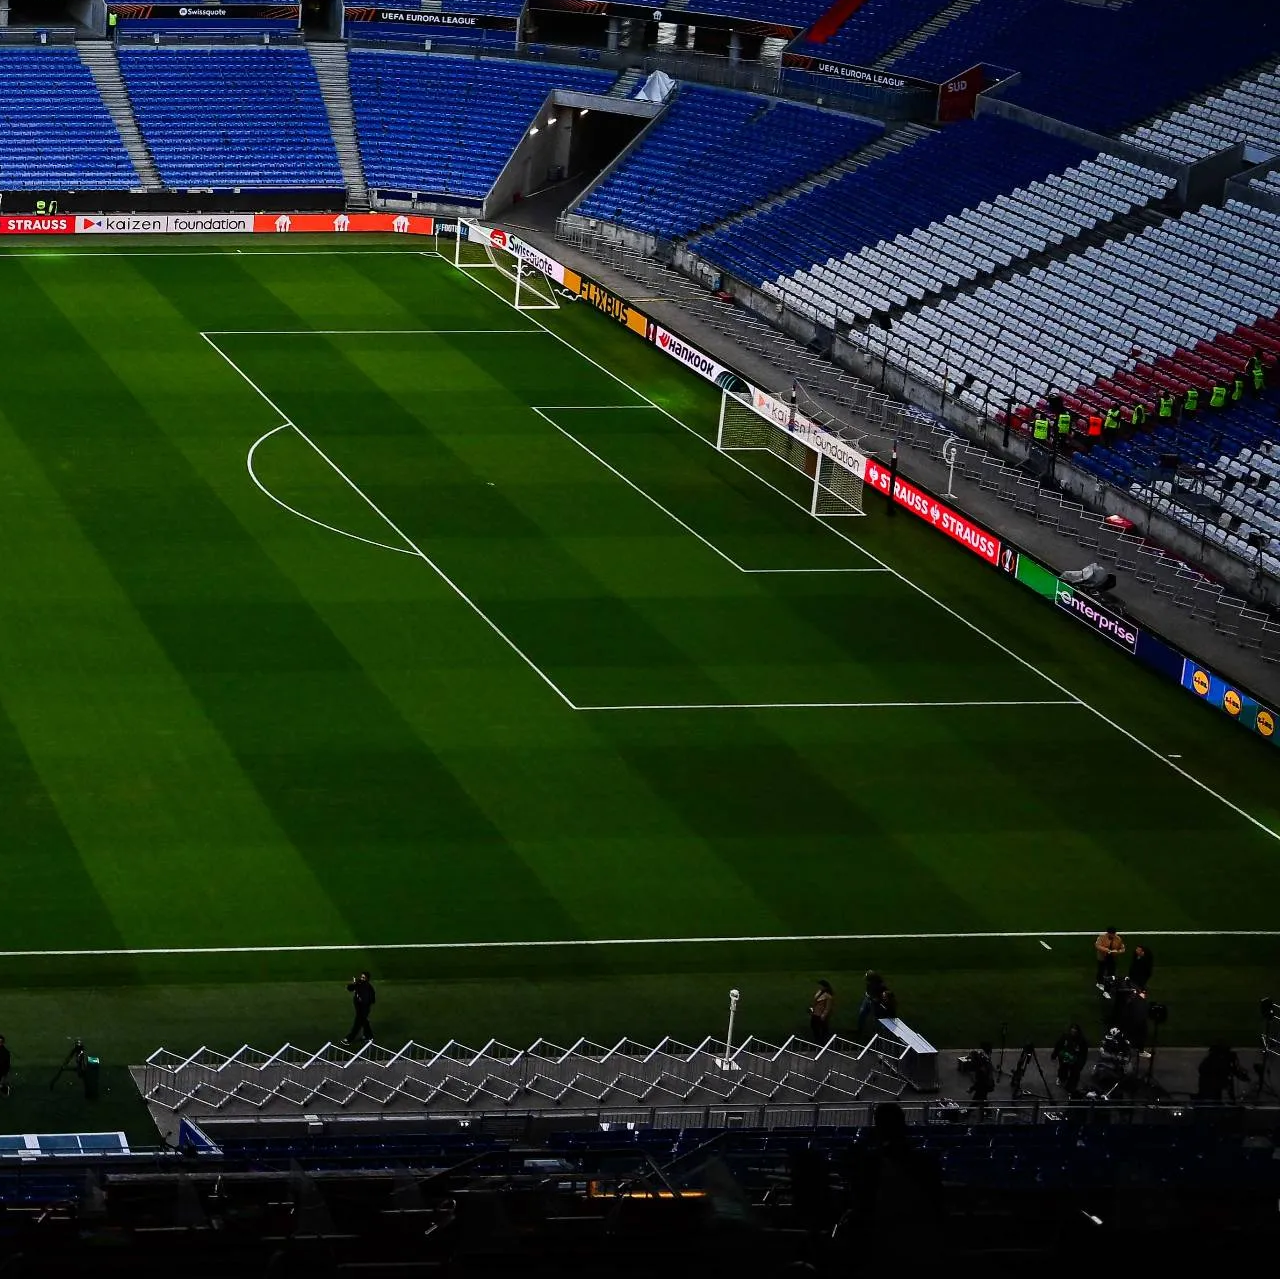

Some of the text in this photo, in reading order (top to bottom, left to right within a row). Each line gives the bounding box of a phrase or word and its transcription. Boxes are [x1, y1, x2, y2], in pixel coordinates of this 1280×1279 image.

[188, 9, 226, 17] Swissquote
[382, 12, 476, 25] UEFA EUROPA LEAGUE
[819, 63, 905, 87] UEFA EUROPA LEAGUE
[947, 80, 967, 93] SUD
[7, 219, 67, 230] STRAUSS
[106, 216, 246, 231] kaizen foundation
[509, 234, 553, 276] Swissquote
[772, 403, 860, 472] kaien foundation
[880, 474, 994, 557] STRAUSS STRAUSS
[1058, 588, 1135, 645] enterprise
